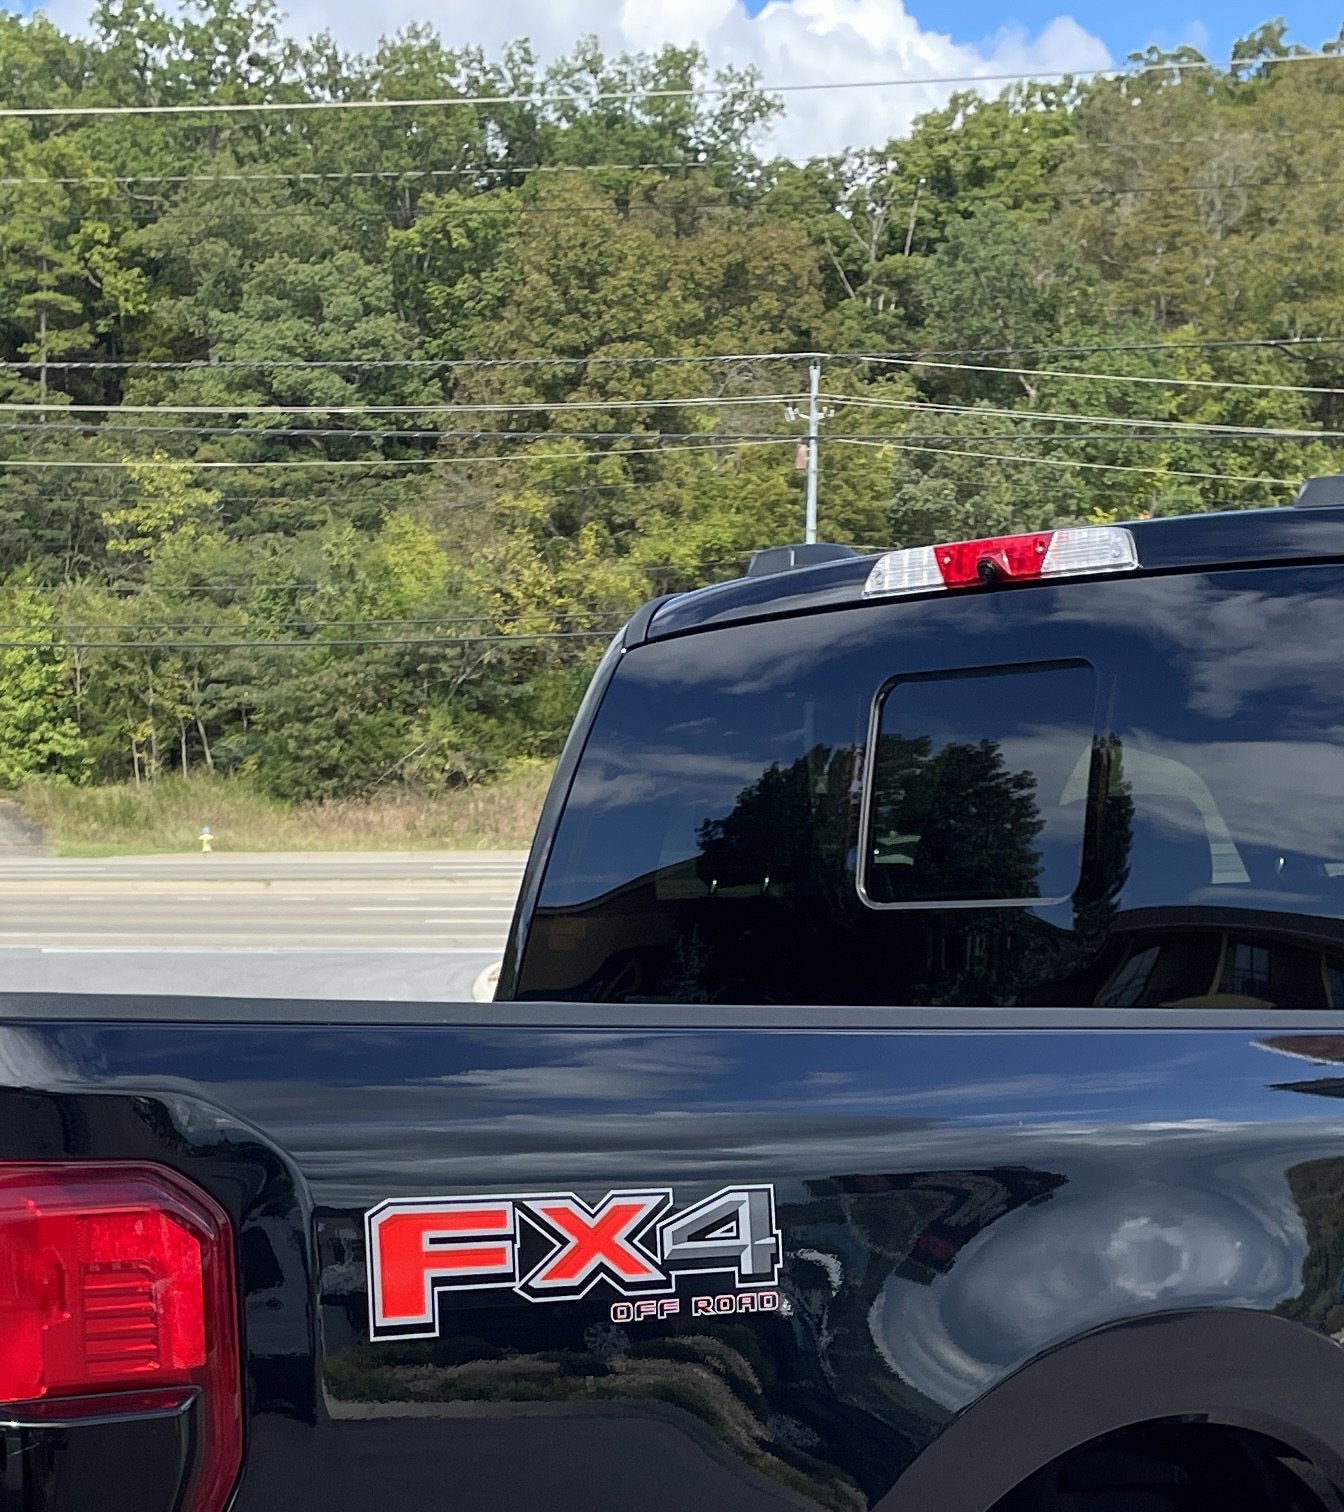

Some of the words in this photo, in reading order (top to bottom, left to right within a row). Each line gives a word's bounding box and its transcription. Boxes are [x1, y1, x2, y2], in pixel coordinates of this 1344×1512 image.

[364, 1184, 783, 1342] FX4
[610, 1299, 681, 1323] OFF
[691, 1291, 780, 1317] ROAD
